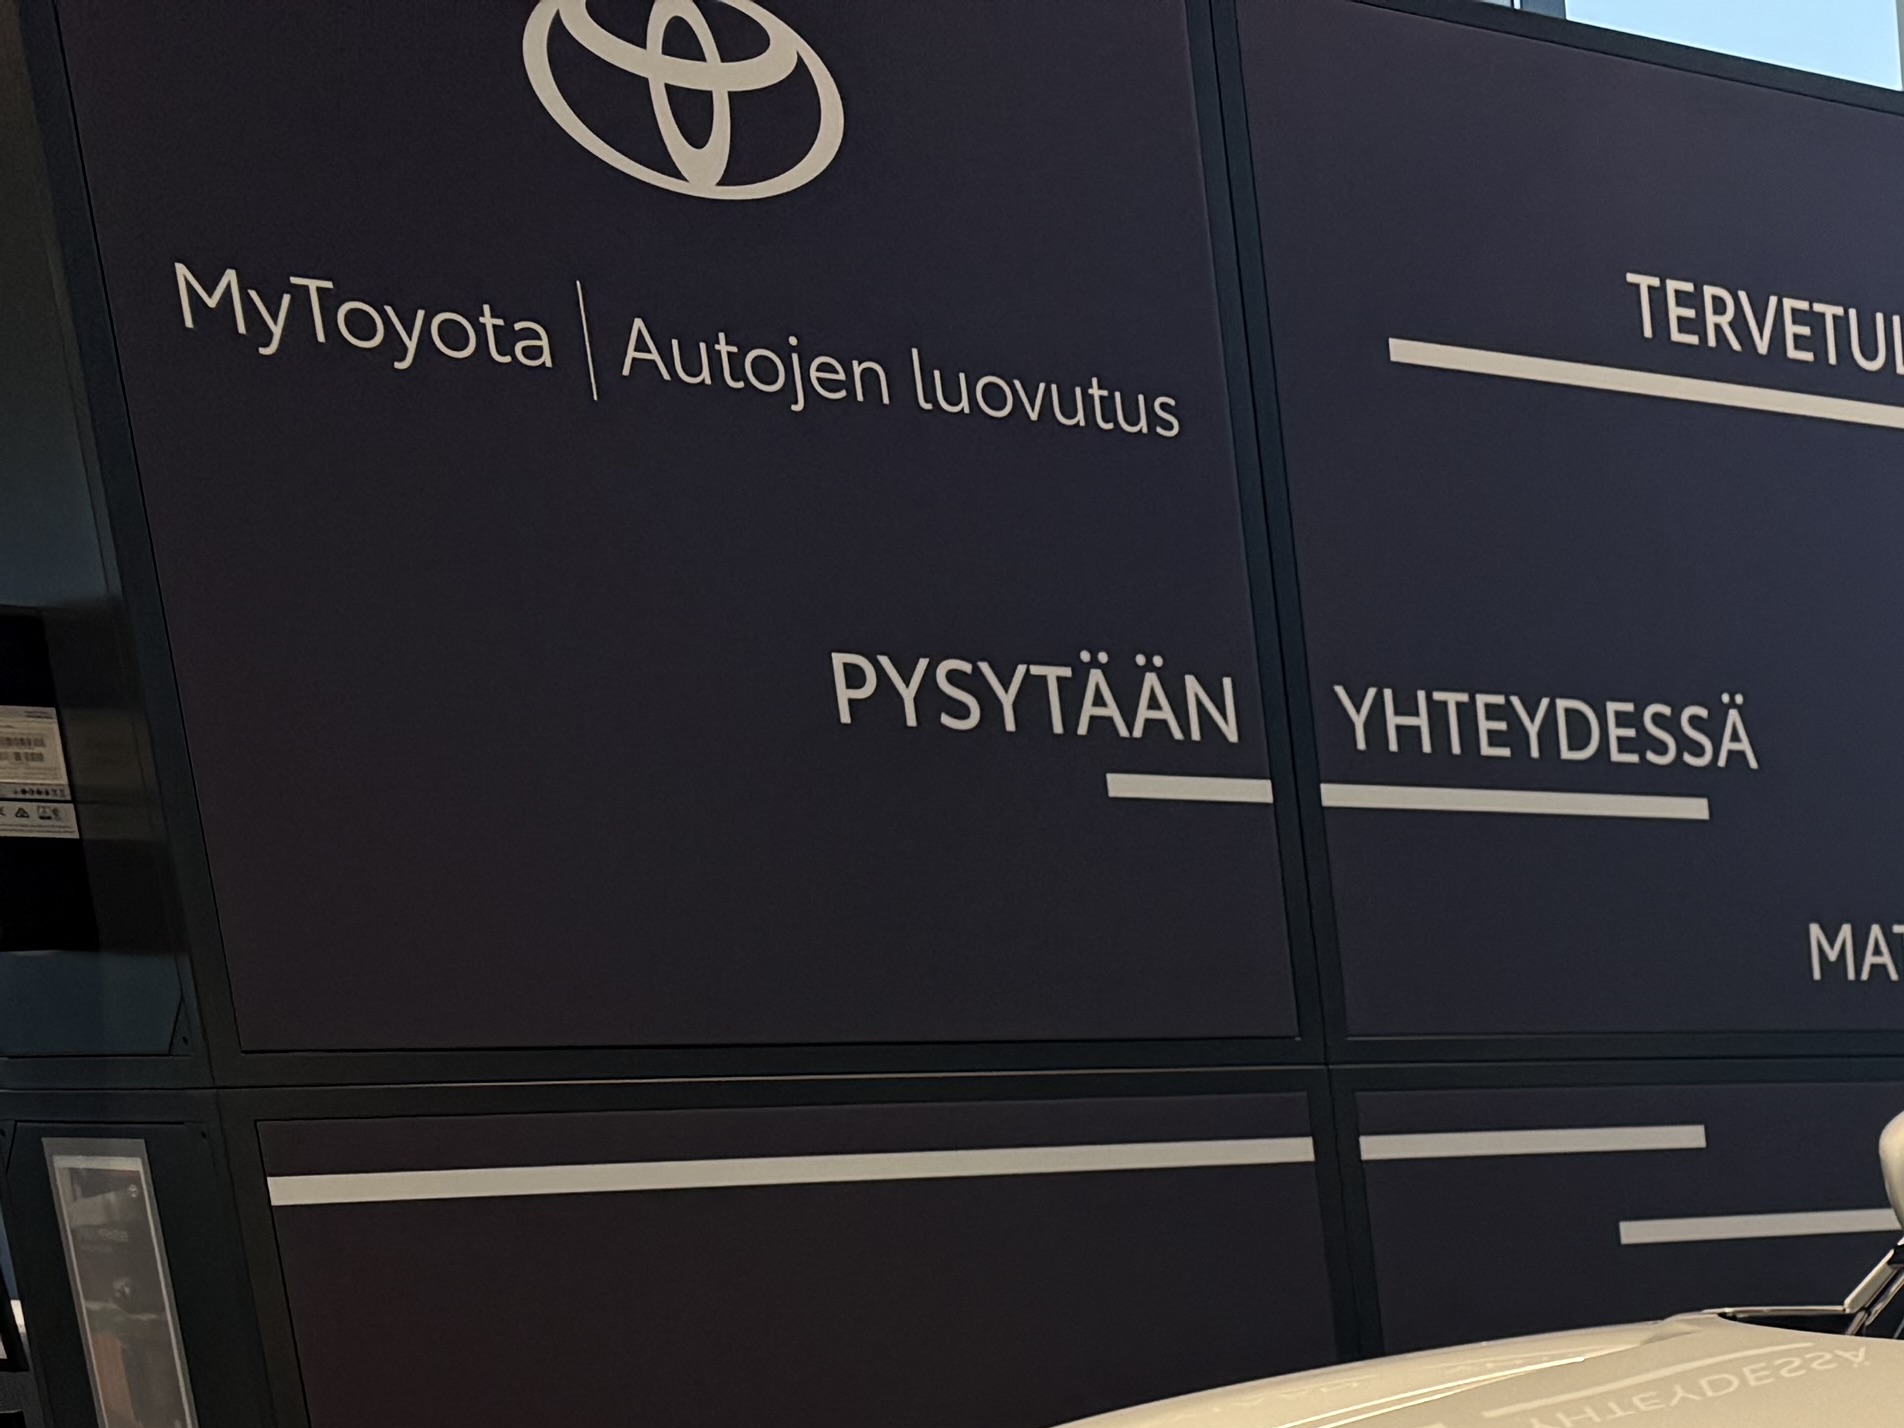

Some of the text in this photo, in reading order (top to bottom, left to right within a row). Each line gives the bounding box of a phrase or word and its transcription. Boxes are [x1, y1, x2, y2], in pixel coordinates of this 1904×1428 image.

[175, 262, 1181, 438] MyToyota Autojen luovutus
[831, 650, 1759, 770] PYSYTÄÄN YHTEYDESSÄ
